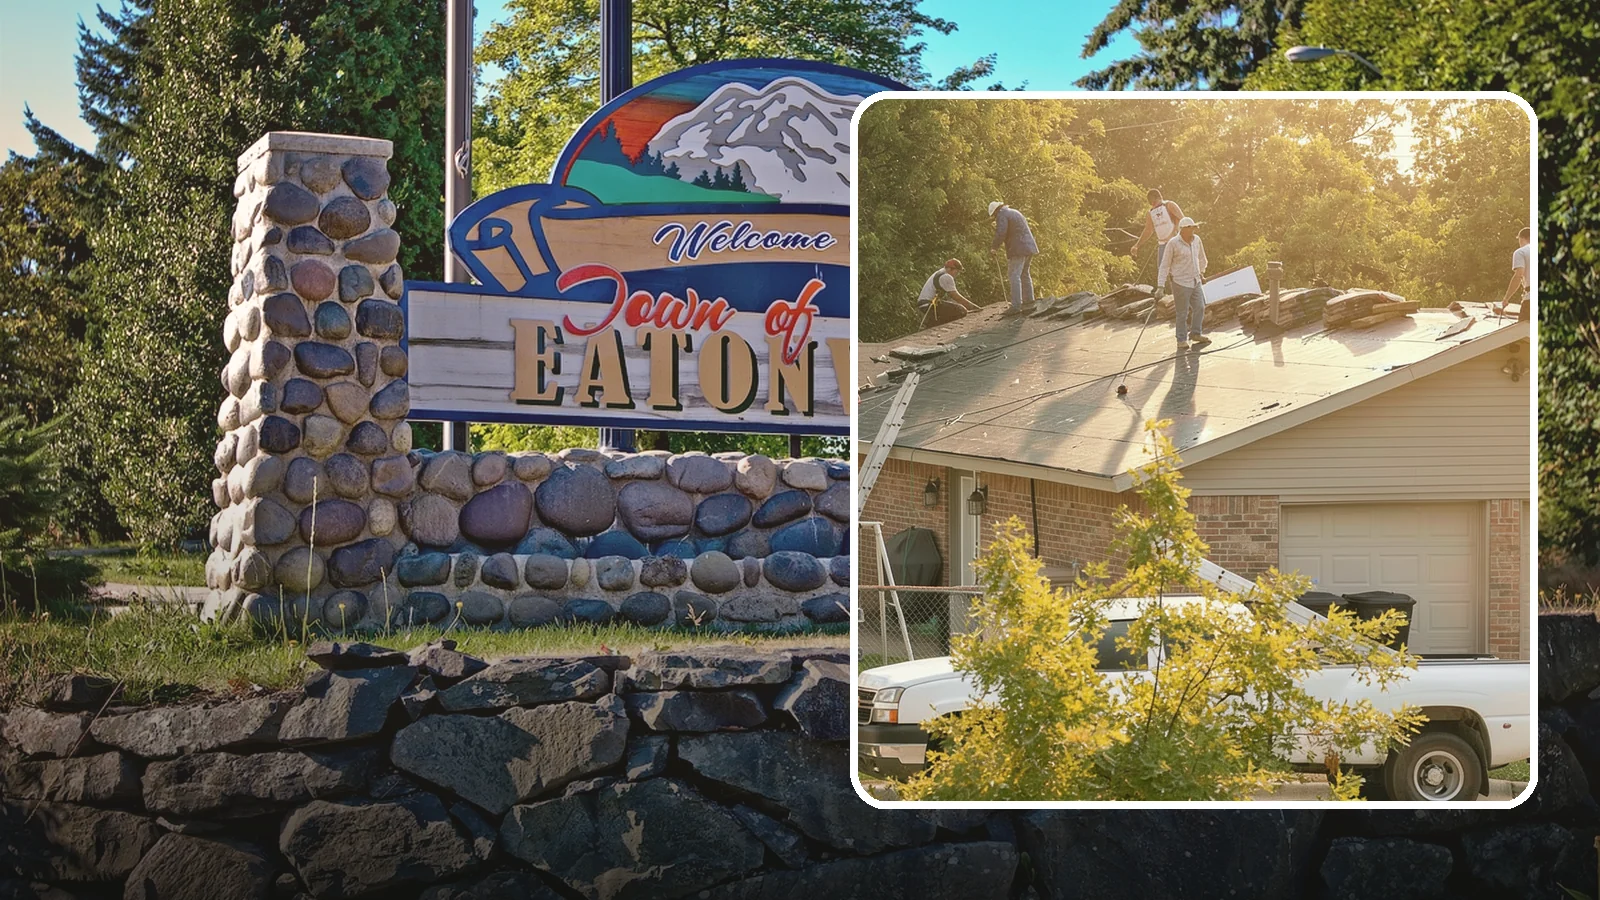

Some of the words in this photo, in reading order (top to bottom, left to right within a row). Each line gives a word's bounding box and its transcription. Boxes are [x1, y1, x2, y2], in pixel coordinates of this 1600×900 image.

[653, 220, 837, 263] Welcome
[556, 263, 736, 336] Town
[764, 278, 826, 365] of
